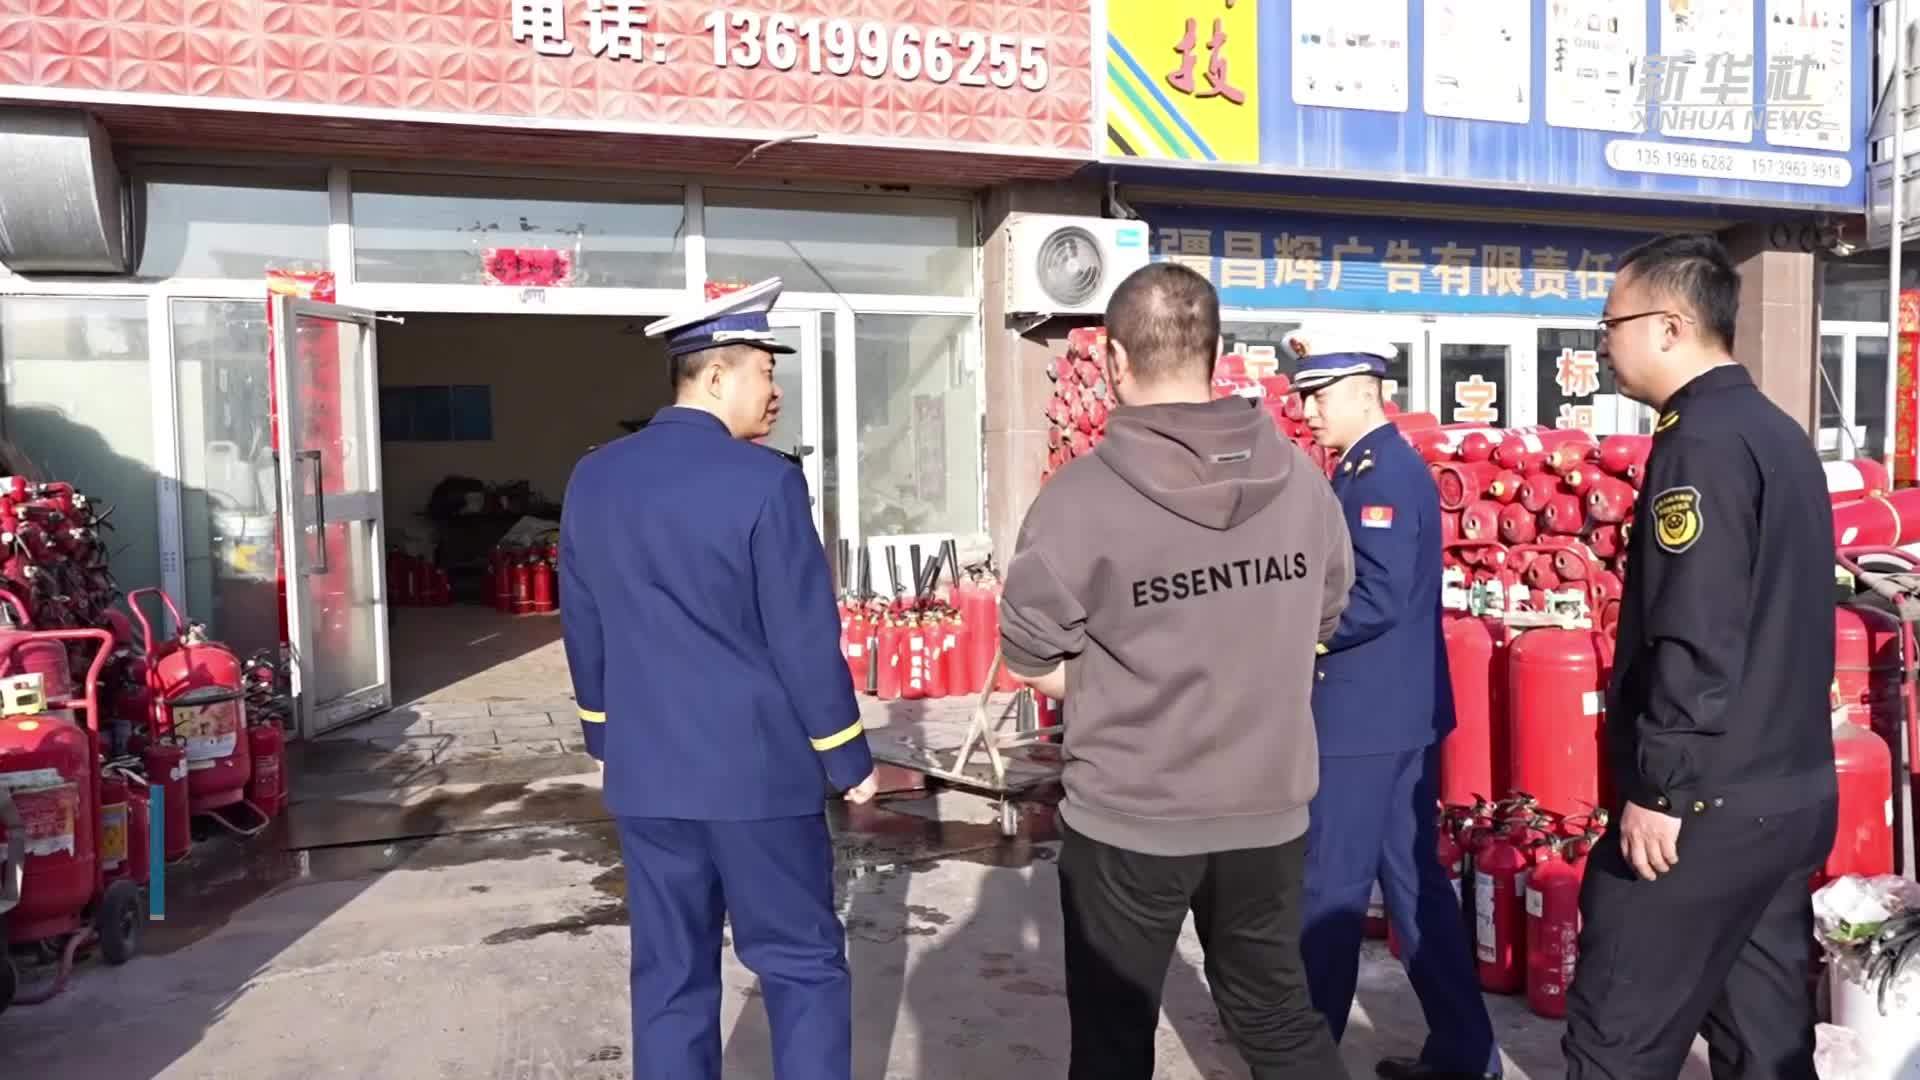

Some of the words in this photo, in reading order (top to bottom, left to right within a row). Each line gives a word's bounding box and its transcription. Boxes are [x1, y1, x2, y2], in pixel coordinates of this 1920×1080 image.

[703, 9, 1050, 92] 13619966255
[1166, 0, 1246, 106] 技
[1150, 228, 1616, 299] 疆昌辉广告有限责任
[1132, 552, 1308, 607] ESSENTIALS
